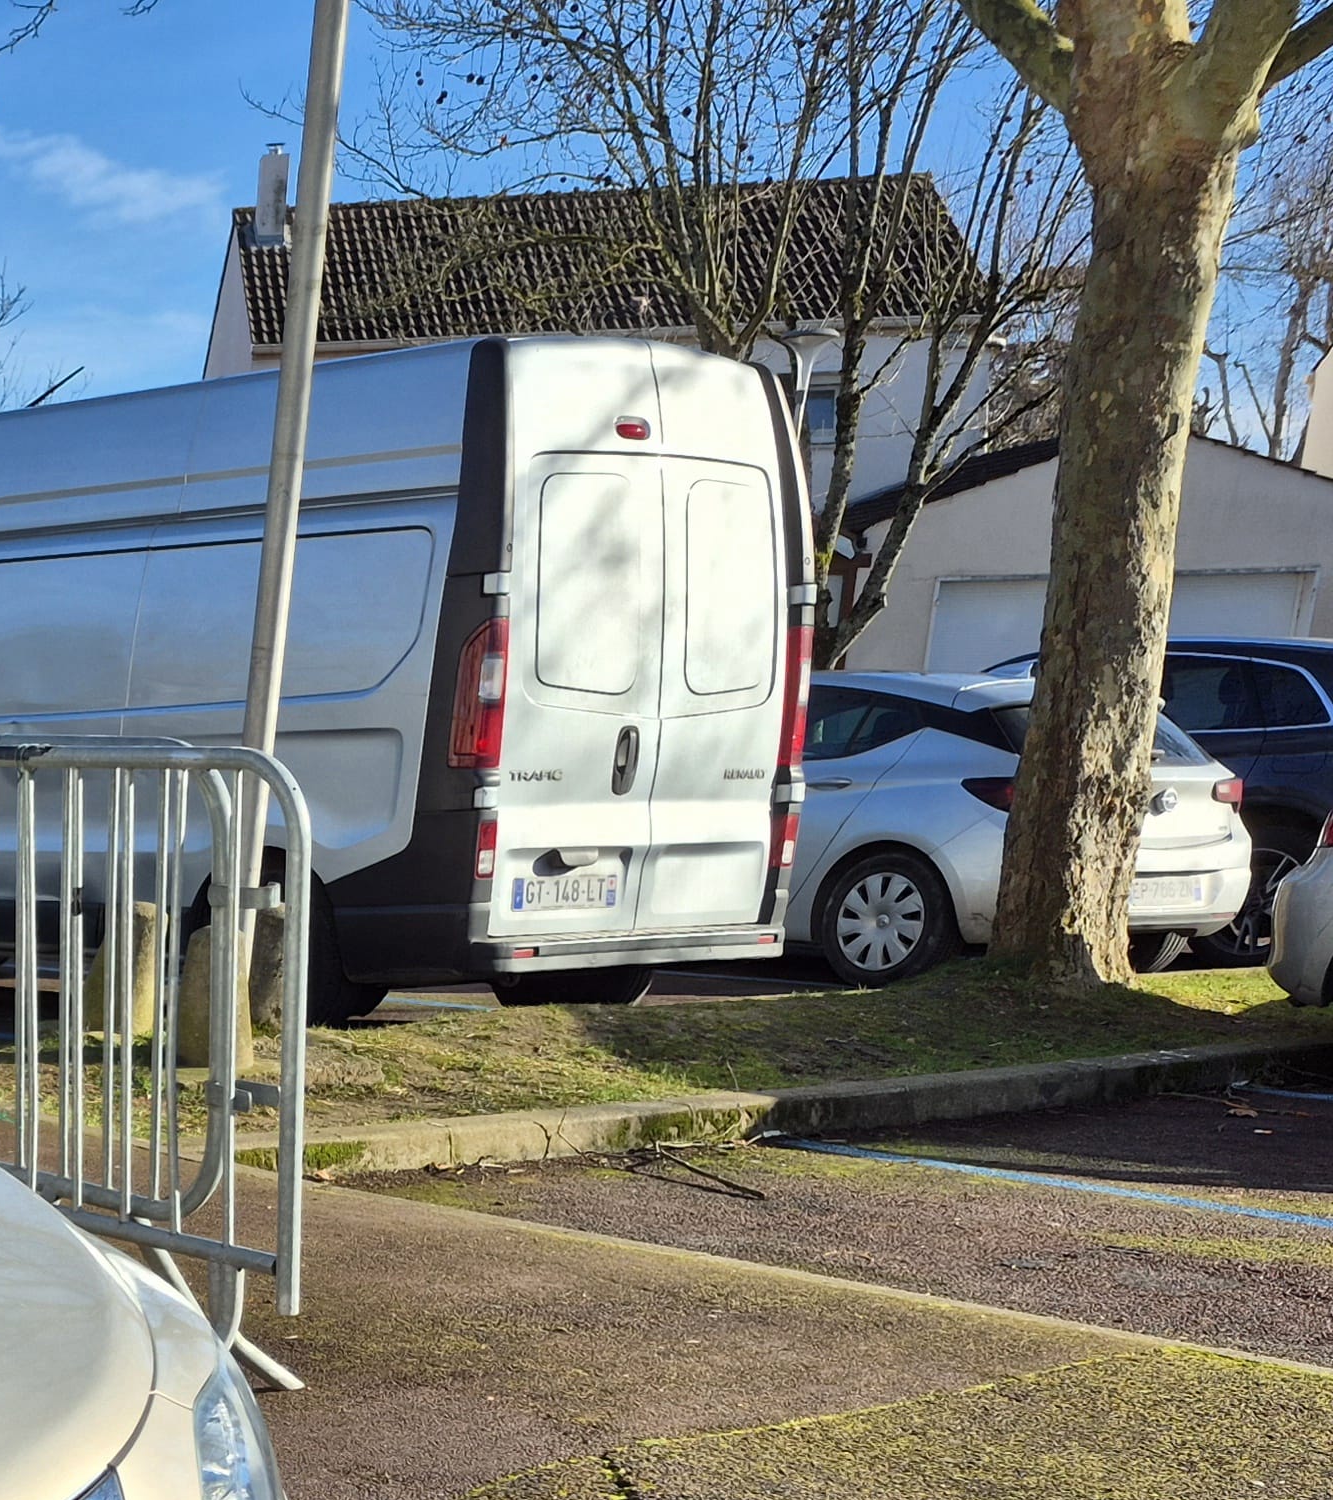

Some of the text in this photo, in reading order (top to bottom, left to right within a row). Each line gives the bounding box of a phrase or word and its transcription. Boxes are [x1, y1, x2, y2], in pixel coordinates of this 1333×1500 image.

[509, 769, 563, 782] TRAFIC
[723, 768, 766, 780] RENAULT
[526, 877, 606, 905] GT-148-LT
